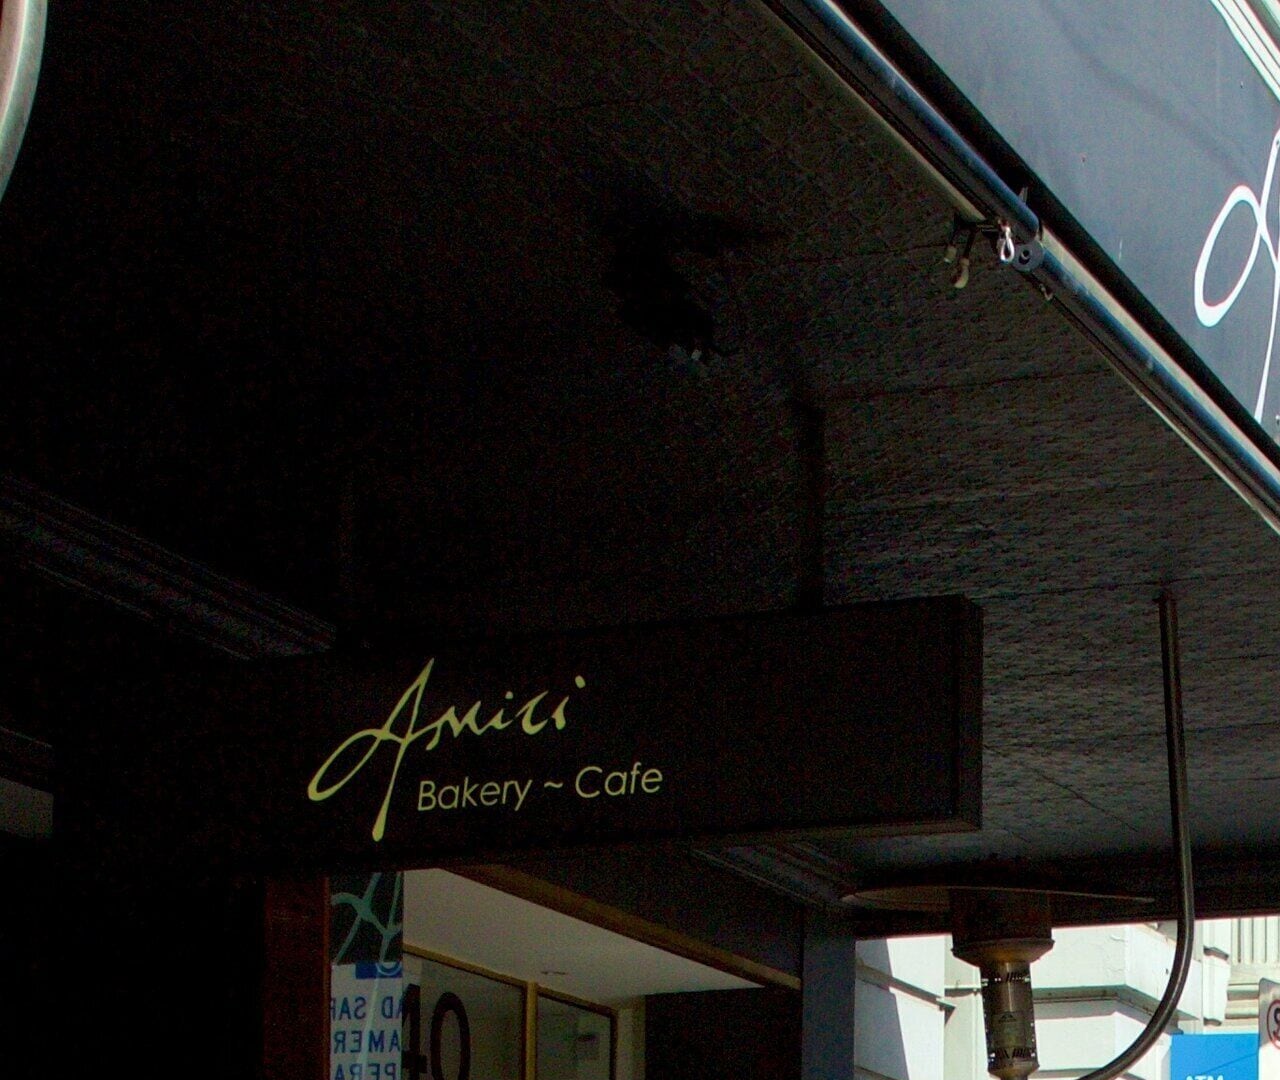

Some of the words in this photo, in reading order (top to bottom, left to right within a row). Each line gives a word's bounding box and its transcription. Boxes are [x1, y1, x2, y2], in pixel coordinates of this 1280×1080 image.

[306, 657, 586, 841] Amici
[416, 777, 532, 811] Bakery
[575, 762, 663, 799] Cafe
